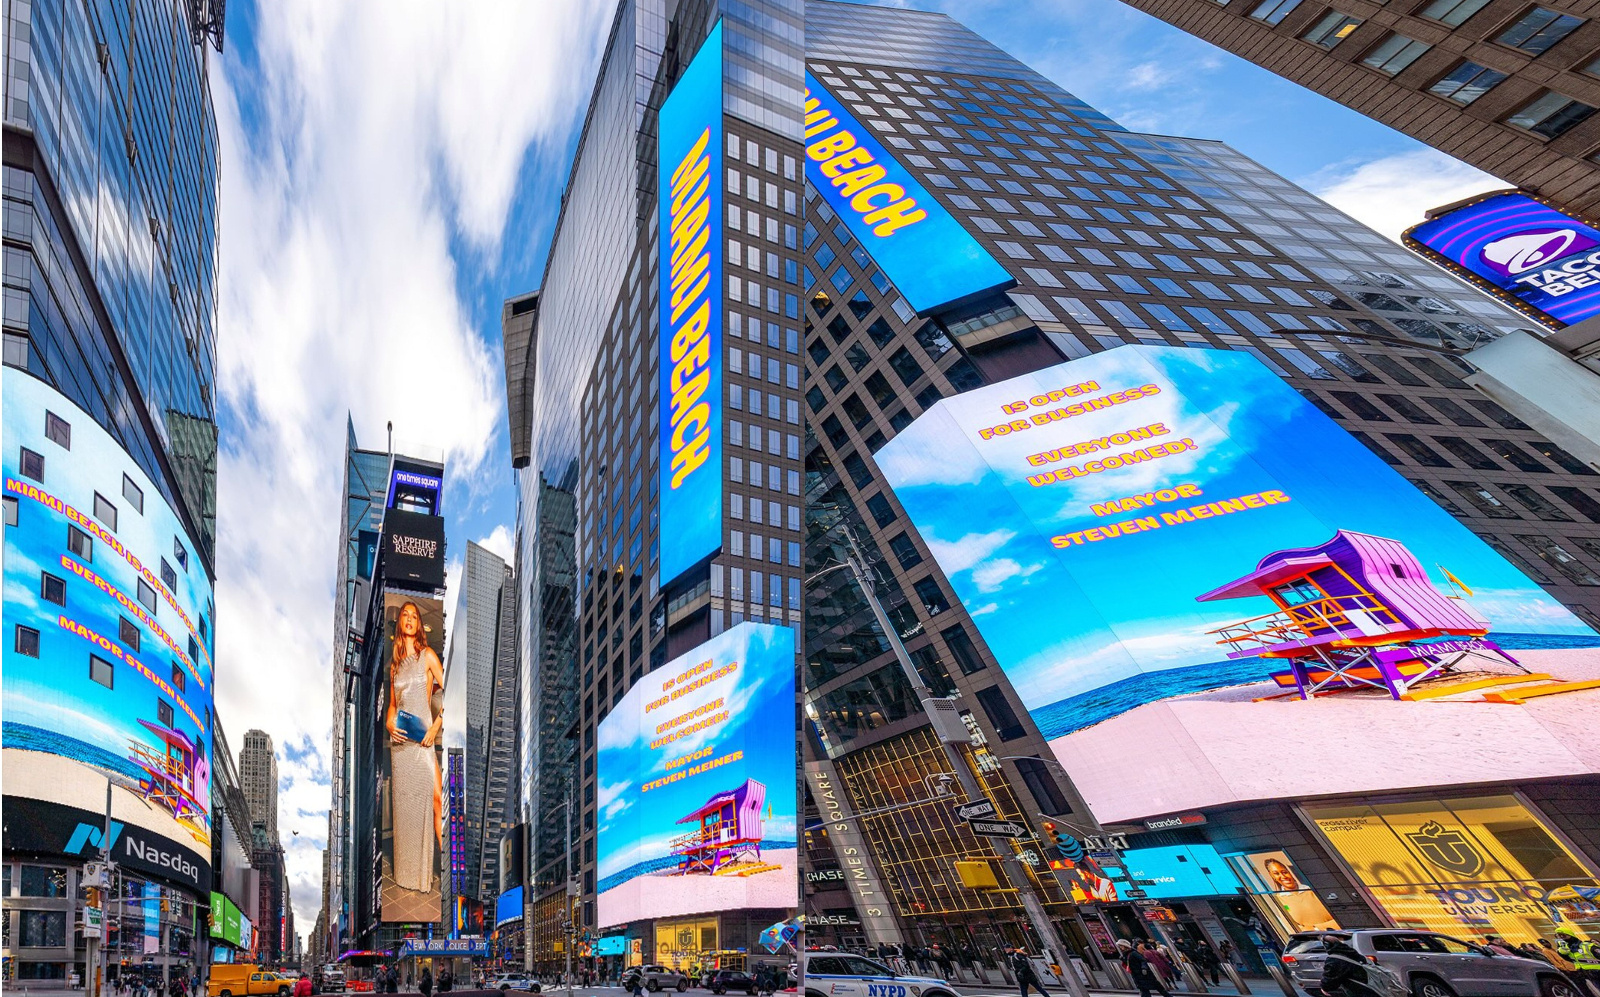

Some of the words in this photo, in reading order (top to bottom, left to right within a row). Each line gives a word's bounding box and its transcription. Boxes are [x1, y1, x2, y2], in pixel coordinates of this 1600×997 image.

[805, 129, 928, 238] BEACH
[670, 124, 711, 326] MIAMI
[670, 297, 711, 490] BEACH
[978, 419, 1030, 440] FOR
[1029, 383, 1162, 427] BUSINESS
[1001, 400, 1029, 415] IS
[1029, 379, 1101, 407] OPEN
[1026, 422, 1171, 467] EVERYONE
[1026, 437, 1199, 488] WELCOMED!
[396, 472, 406, 482] one
[407, 474, 420, 484] times
[421, 477, 438, 488] square
[1090, 483, 1203, 517] MAYOR
[1050, 516, 1161, 549] STEVEN
[1160, 489, 1292, 526] MEINER
[6, 477, 64, 514] MIAMI
[65, 503, 125, 557] BEACH
[125, 548, 142, 571] IS
[142, 567, 178, 610] OPEN
[178, 605, 196, 637] FOR
[392, 534, 437, 551] SAPPHIRE
[395, 543, 435, 558] RESERVE
[60, 554, 148, 624] EVERYONE
[148, 618, 205, 690] WELCOMED!
[58, 615, 123, 659] MAYOR
[125, 652, 175, 700] STEVEN
[175, 693, 205, 734] MEINER
[645, 696, 669, 713] FOR
[671, 662, 738, 701] BUSINESS
[662, 678, 675, 691] IS
[676, 658, 713, 684] OPEN
[650, 710, 729, 750] WELCOMED!
[656, 697, 724, 734] EVERYONE
[642, 770, 686, 792] STEVEN
[688, 750, 743, 776] MEINER
[665, 746, 713, 770] MAYOR
[815, 772, 848, 831] SQUARE
[961, 808, 975, 817] ONE
[976, 803, 990, 813] WAY
[978, 824, 996, 832] ONE
[1001, 824, 1020, 833] WAY
[126, 836, 198, 883] Nasdaq
[807, 870, 844, 881] CHASE
[844, 847, 874, 897] TIMES
[867, 907, 882, 917] 3
[1424, 886, 1549, 905] TOURO
[805, 915, 849, 925] HASE
[868, 984, 906, 997] NYPD
